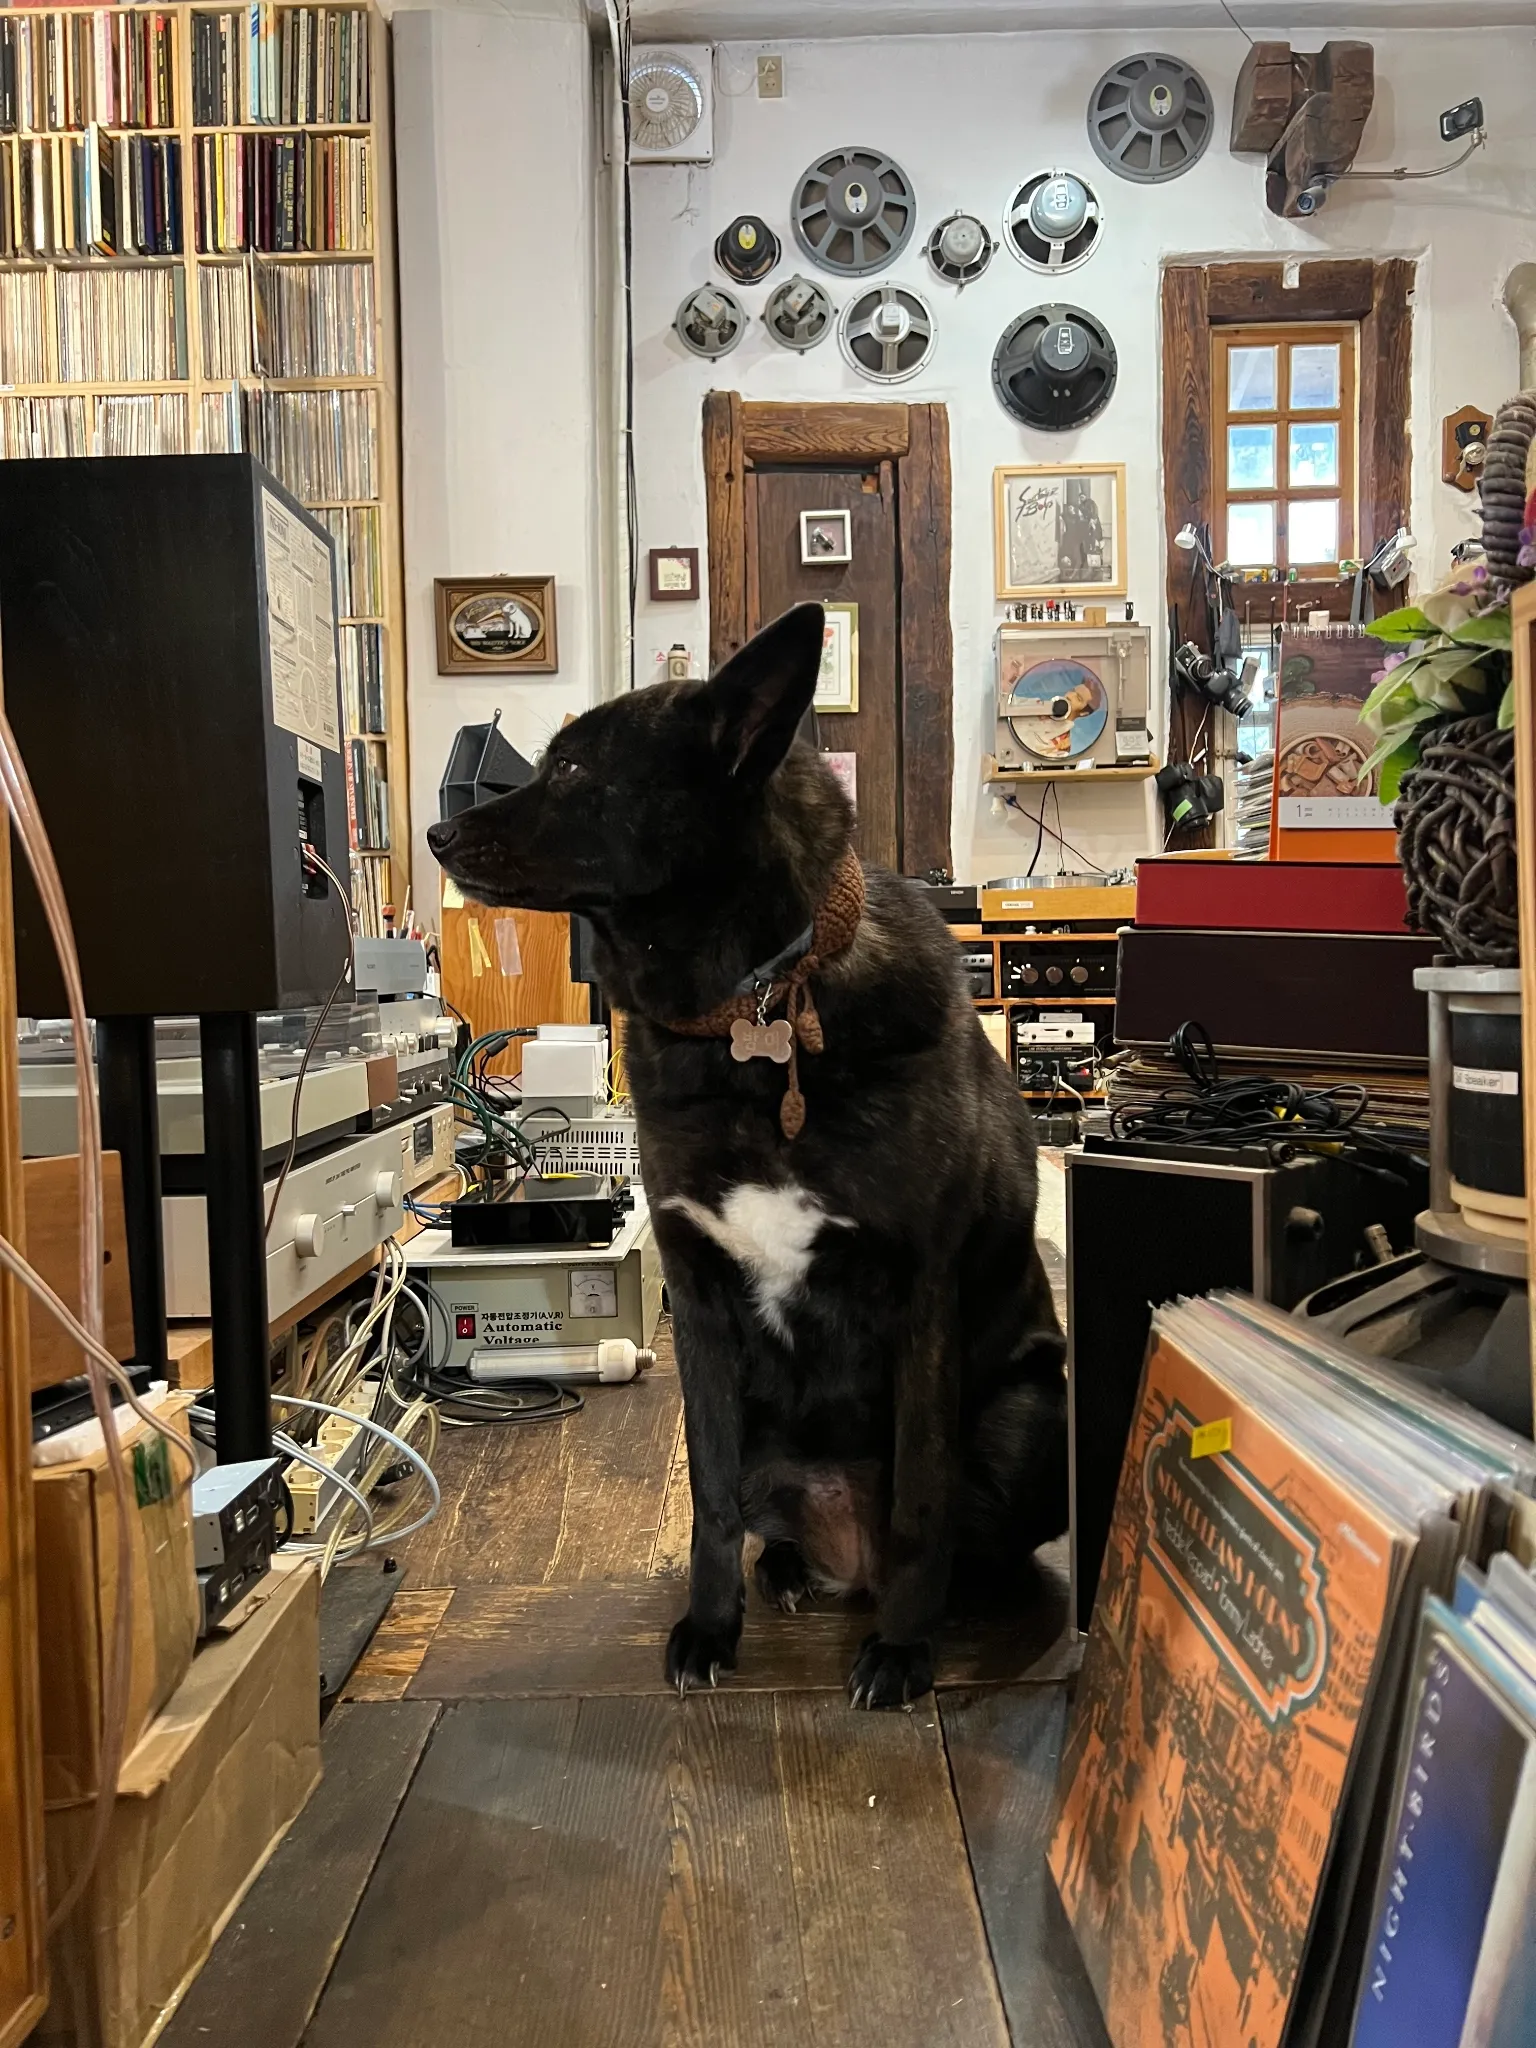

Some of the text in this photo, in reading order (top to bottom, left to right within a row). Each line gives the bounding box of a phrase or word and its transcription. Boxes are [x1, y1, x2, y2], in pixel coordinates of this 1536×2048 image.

[483, 1321, 563, 1333] Automatic
[483, 1335, 540, 1345] Voltage
[1371, 1660, 1450, 2003] NIGHT BIRDS
